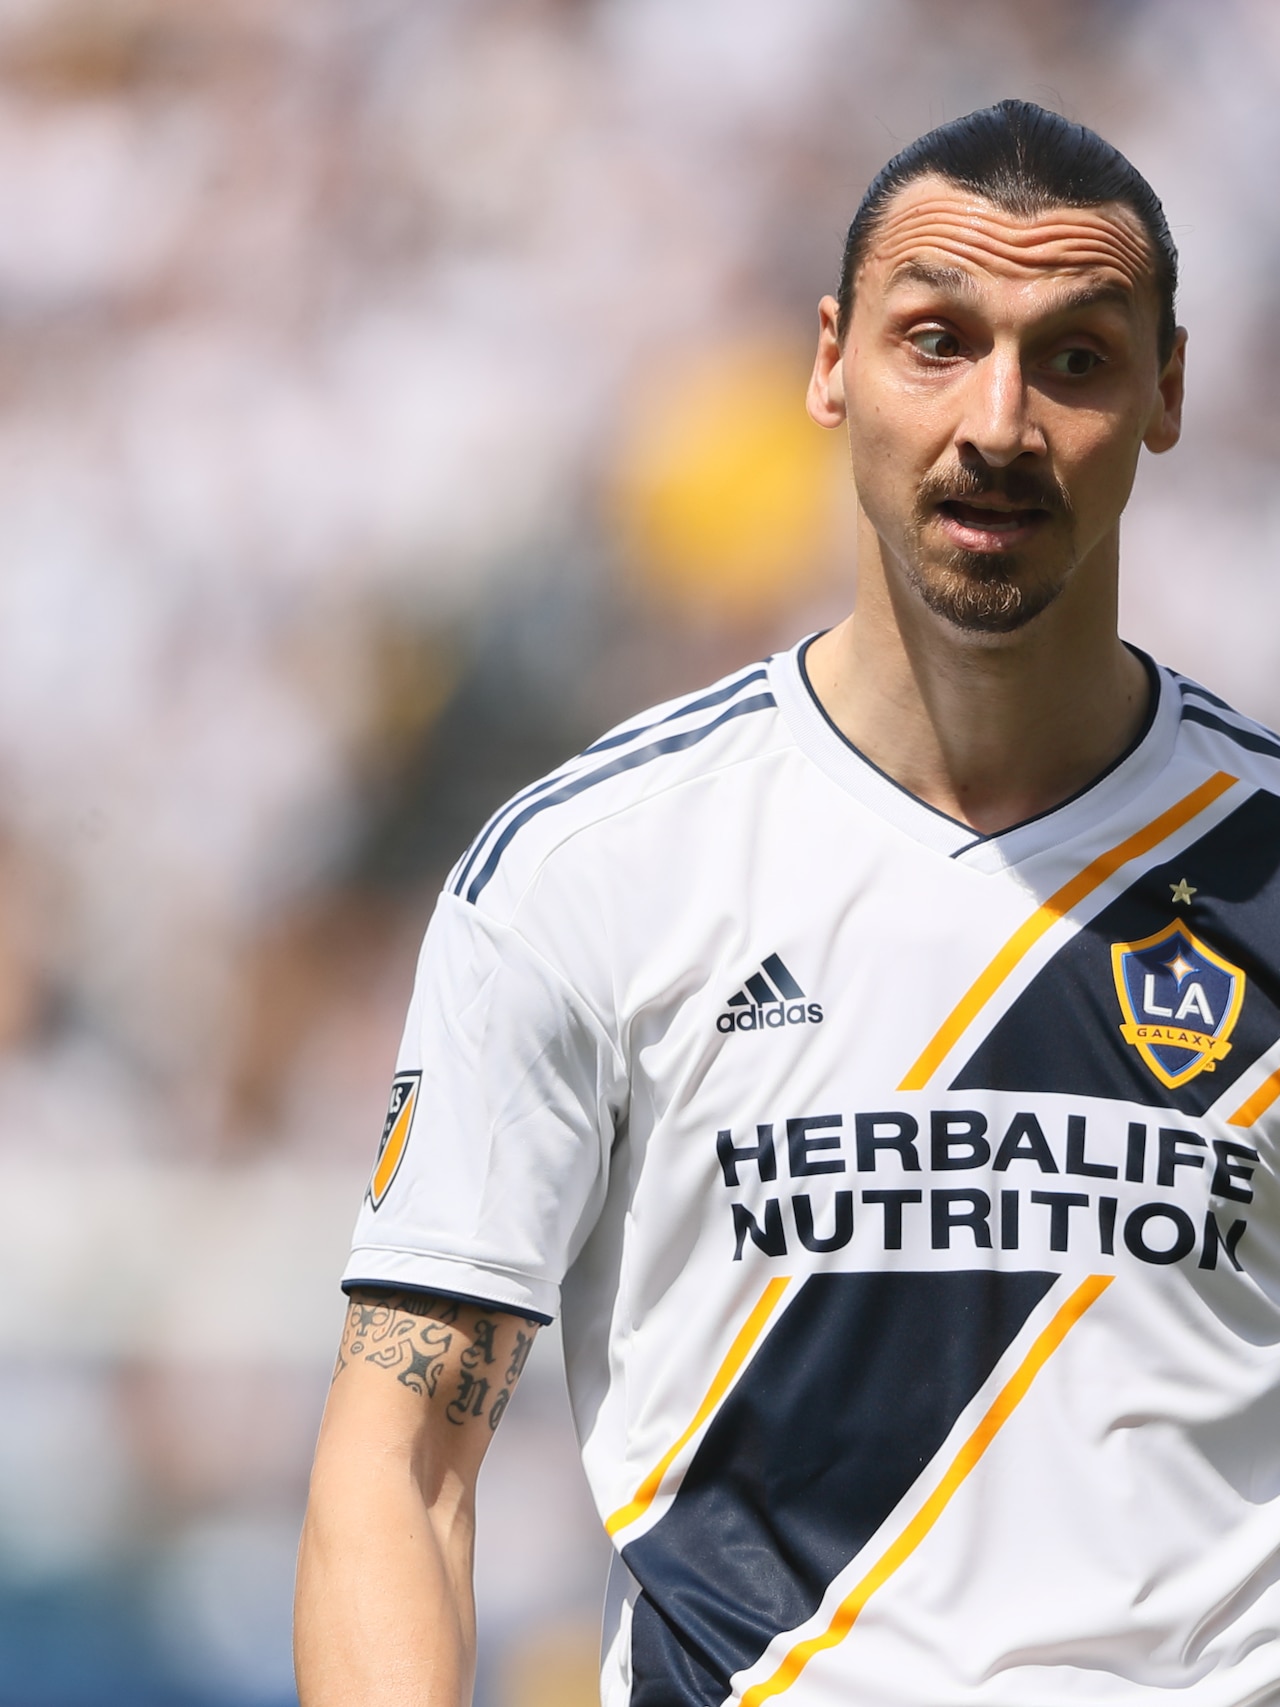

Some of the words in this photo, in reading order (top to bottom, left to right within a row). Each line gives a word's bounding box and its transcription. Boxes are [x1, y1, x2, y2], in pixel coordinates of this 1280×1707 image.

[716, 1001, 824, 1034] adidas
[1143, 974, 1214, 1026] LA
[1136, 1027, 1216, 1050] GALAXY
[717, 1110, 1261, 1205] HERBALIFE
[732, 1188, 1248, 1272] NUTRITION
